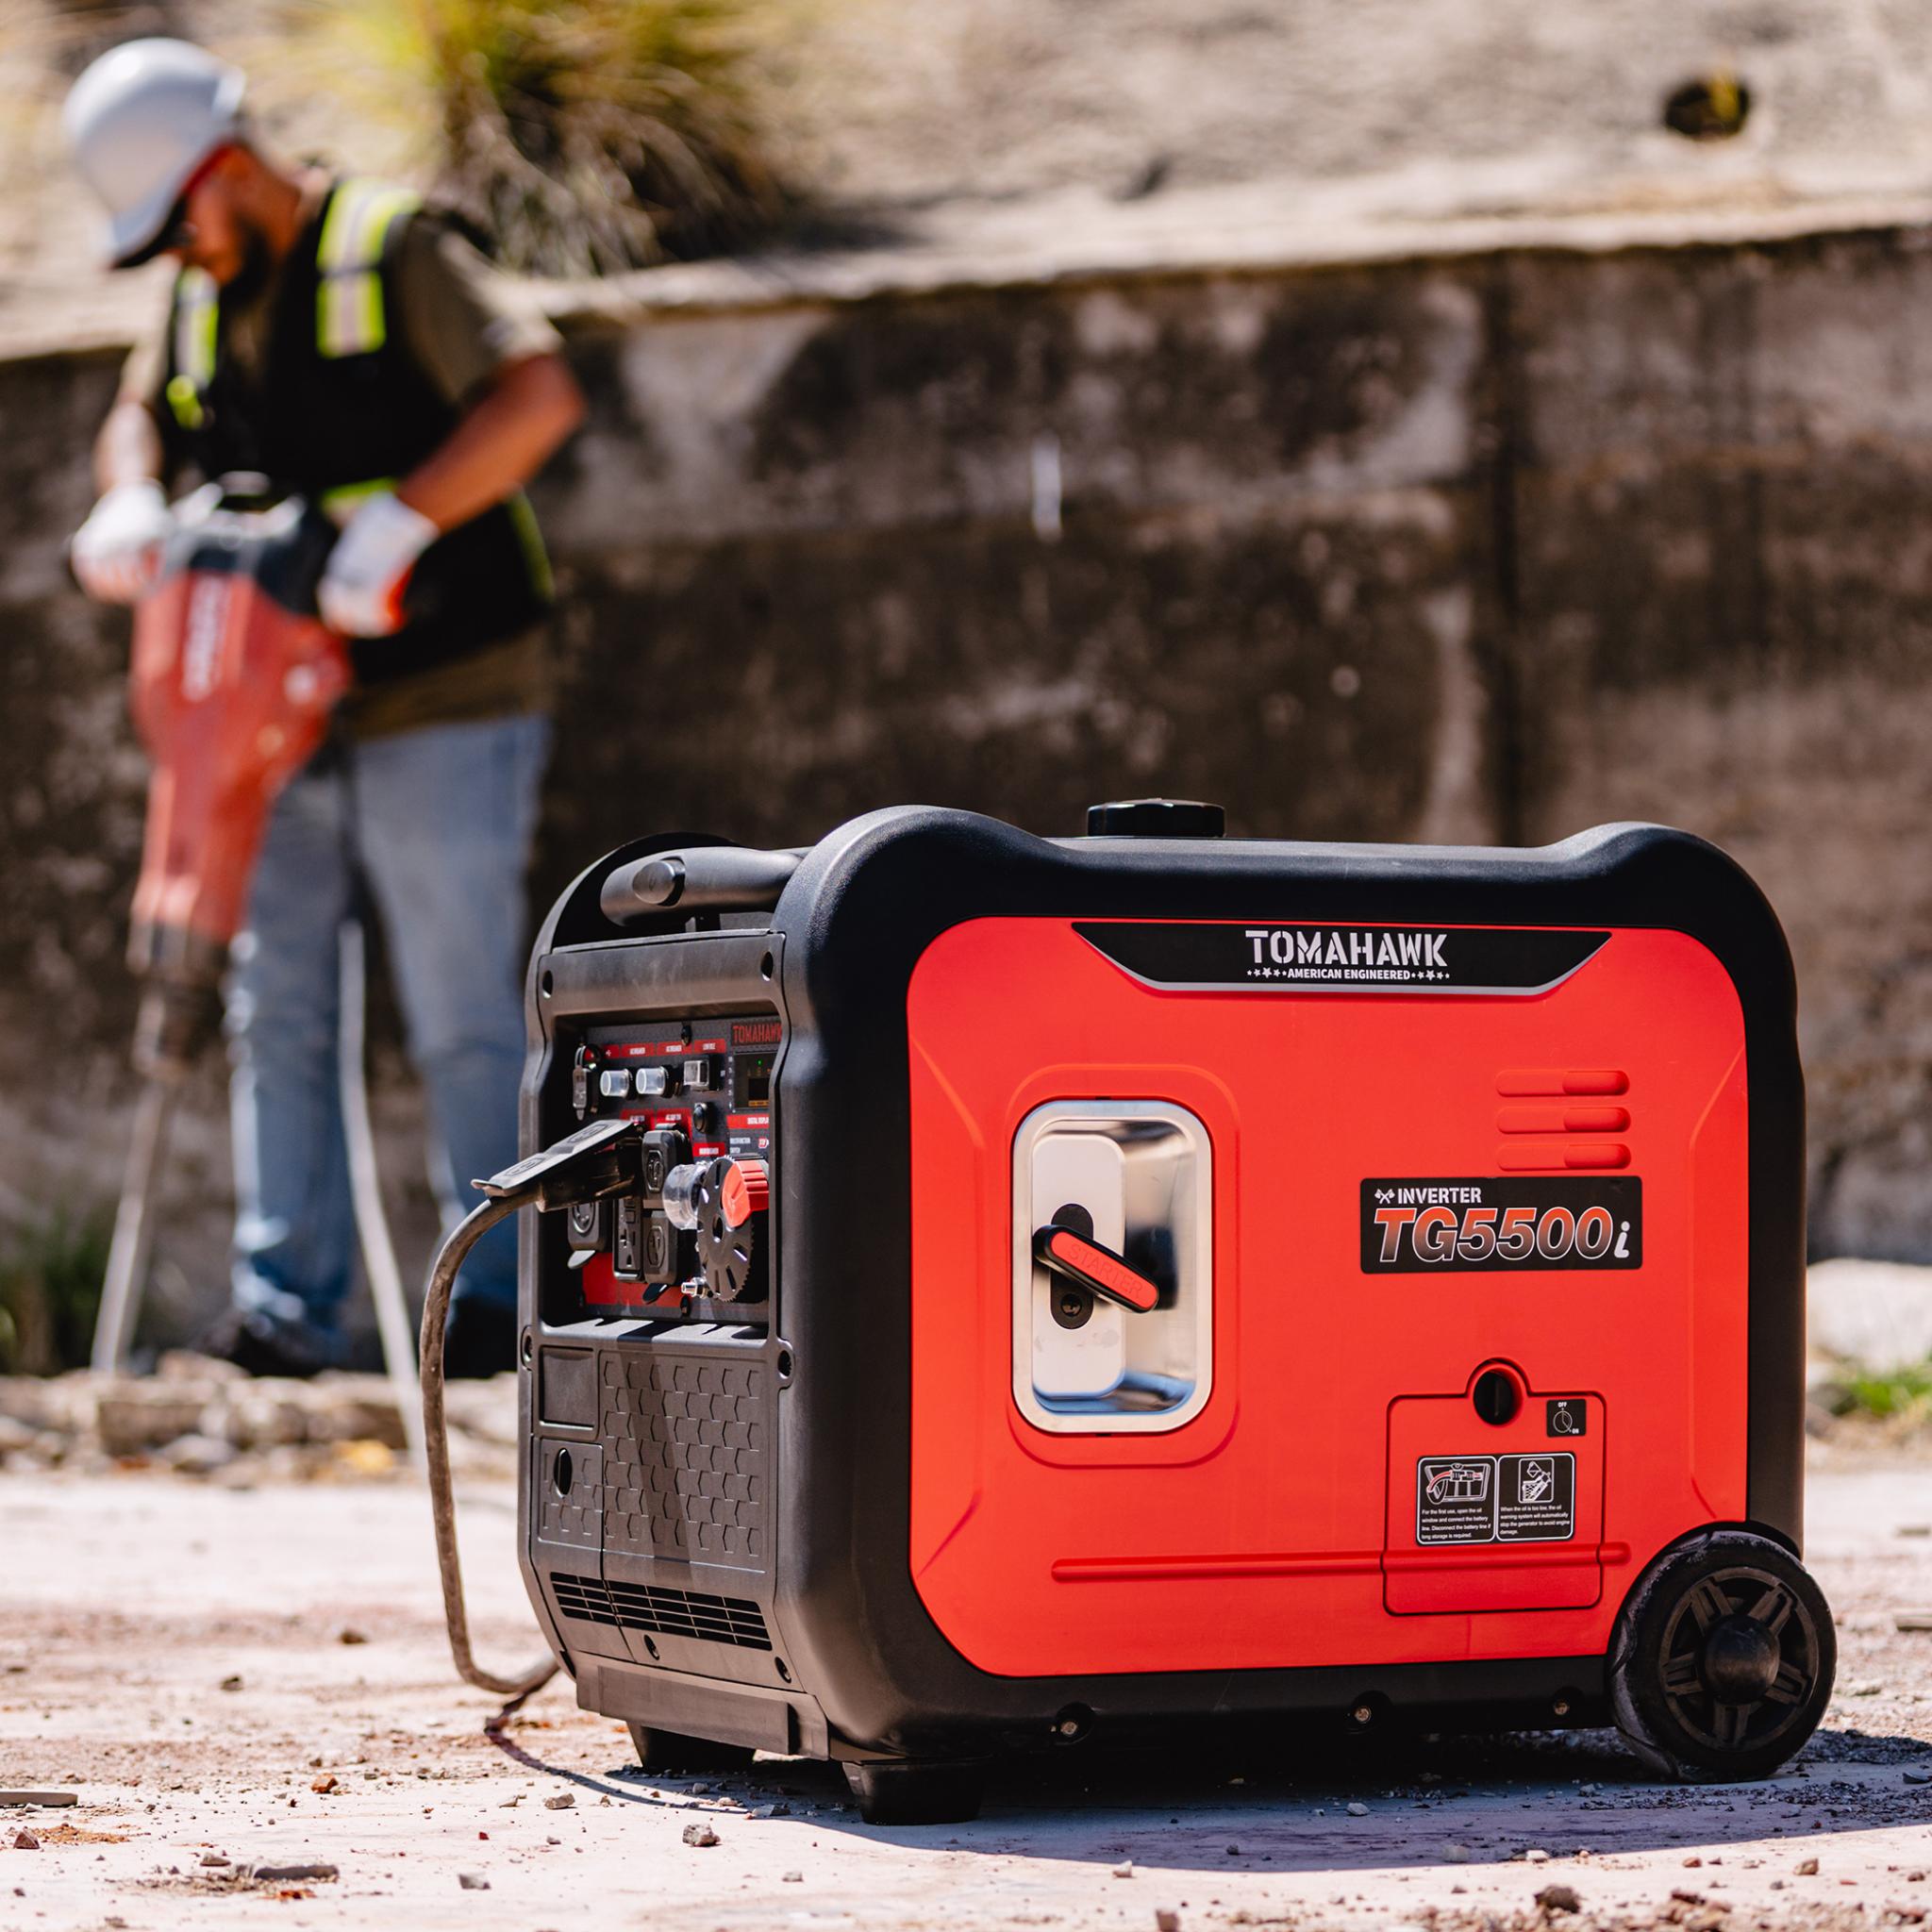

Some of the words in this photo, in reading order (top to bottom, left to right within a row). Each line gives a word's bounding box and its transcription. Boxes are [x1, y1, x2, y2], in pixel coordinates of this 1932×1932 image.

[1245, 930, 1448, 967] TOMAHAWK
[1287, 968, 1342, 979] AMERICAN
[1344, 969, 1411, 980] ENGINEERED
[1397, 1188, 1482, 1205] INVERTER
[1374, 1206, 1630, 1263] TG5500i
[1068, 1243, 1143, 1299] STARTER
